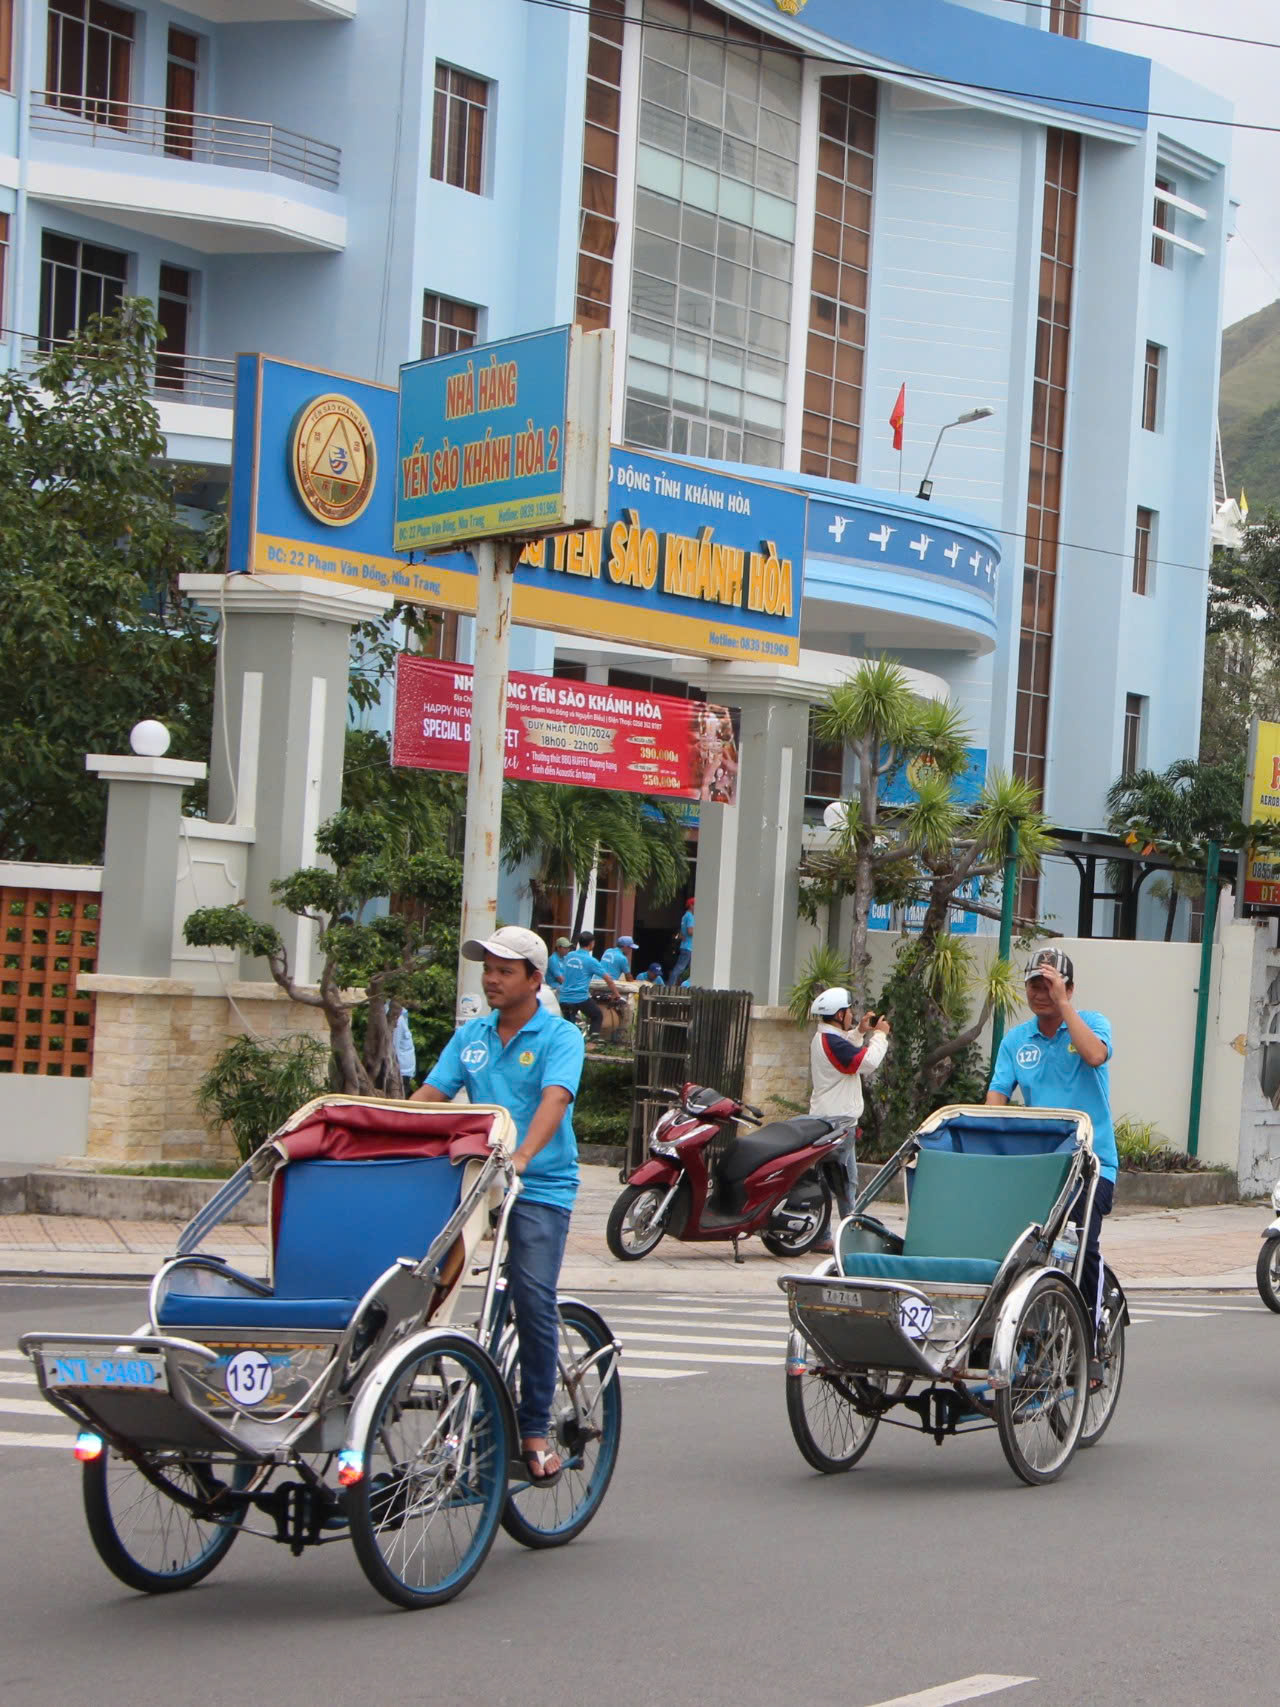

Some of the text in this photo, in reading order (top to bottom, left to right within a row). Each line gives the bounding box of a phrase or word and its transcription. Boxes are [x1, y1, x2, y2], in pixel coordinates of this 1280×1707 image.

[446, 354, 517, 420] NHÀ HÀNG
[403, 437, 430, 500] YẾN
[432, 437, 460, 494] SÀO
[462, 427, 512, 488] KHÁNH
[514, 418, 544, 478] HÒA
[547, 425, 559, 473] 2
[617, 464, 650, 492] ĐỘNG
[654, 471, 681, 499] TỈNH
[685, 484, 724, 509] KHÁNH
[728, 491, 750, 515] HÒA
[290, 550, 304, 567] 22
[308, 553, 336, 575] Phạm
[392, 570, 410, 589] Nha
[414, 573, 441, 596] Trang
[608, 509, 659, 590] SÀO
[662, 526, 744, 608] KHÁNH
[748, 541, 793, 618] HÒA
[423, 702, 451, 716] HAPPY
[454, 674, 473, 691] NH
[530, 681, 556, 705] YẾN
[559, 687, 585, 709] SÀO
[588, 693, 633, 716] KHÁNH
[636, 699, 662, 720] HÒA
[423, 718, 463, 741] SPECIAL
[541, 735, 566, 748] 18h00
[574, 740, 599, 752] 22h00
[569, 724, 611, 739] 01/01/2024
[1019, 1050, 1038, 1062] 127
[900, 1306, 931, 1328] 127
[230, 1363, 270, 1391] 137
